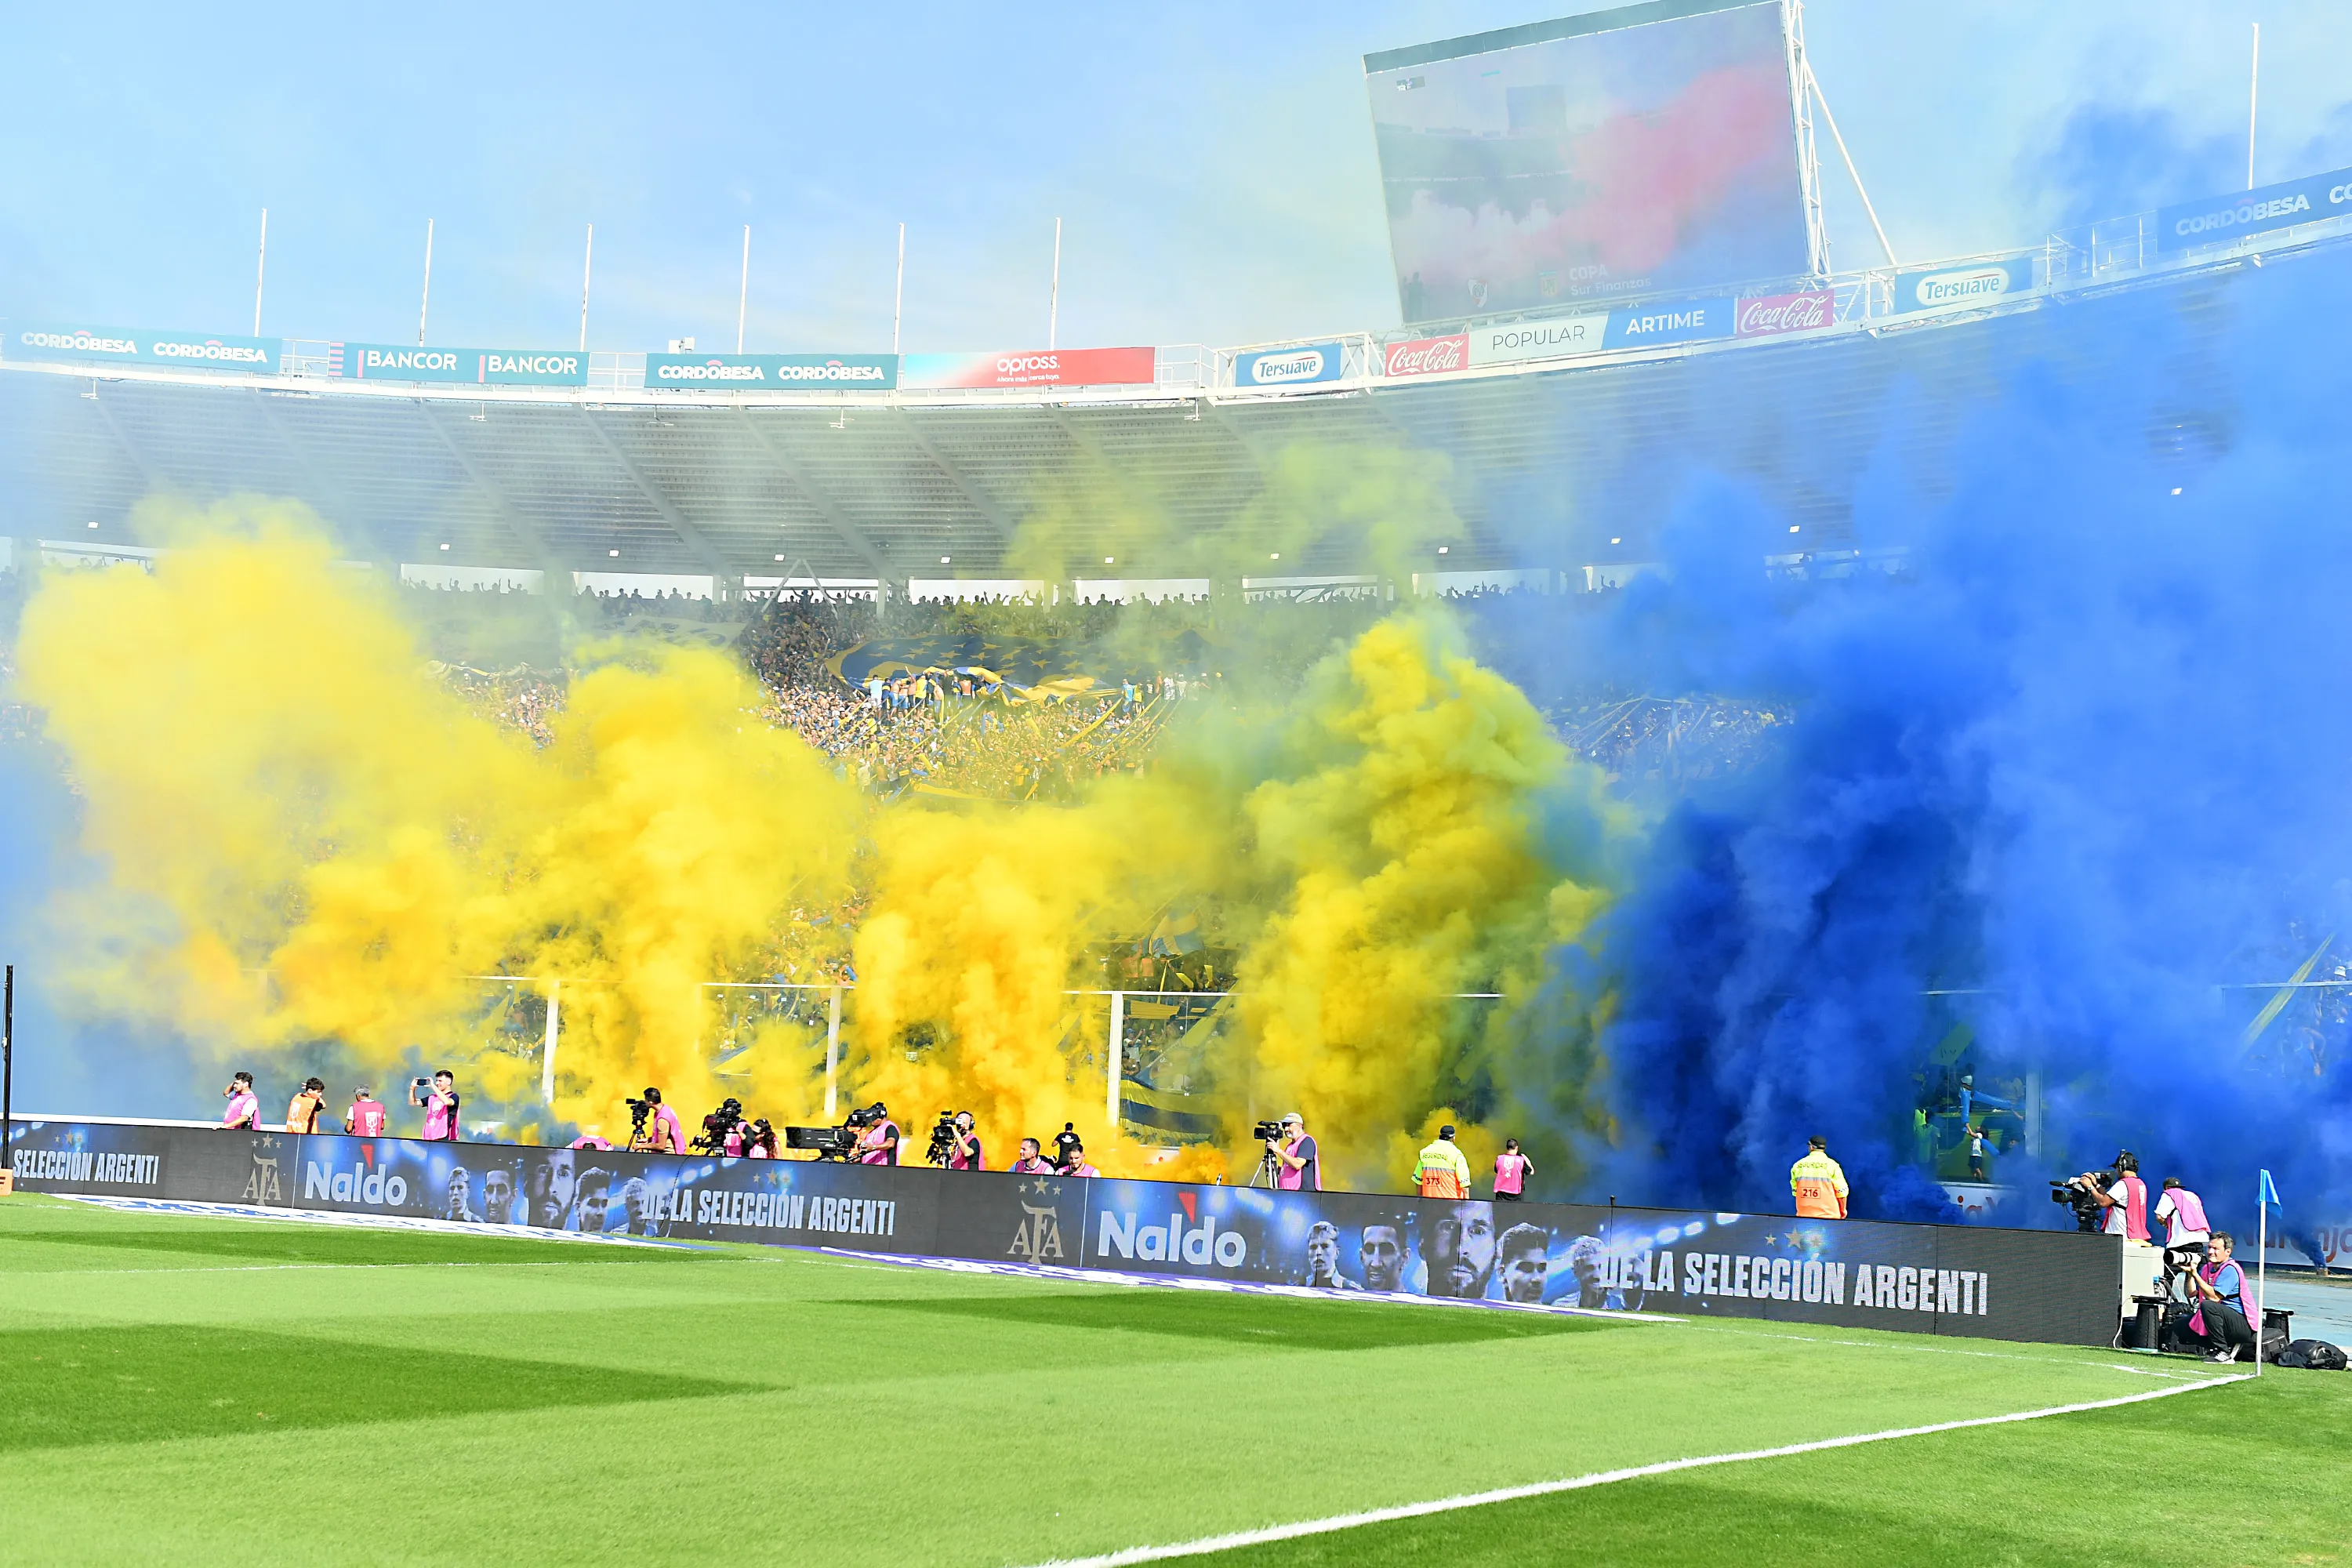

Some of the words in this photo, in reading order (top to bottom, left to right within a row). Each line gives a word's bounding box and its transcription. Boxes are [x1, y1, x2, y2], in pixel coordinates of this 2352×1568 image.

[2176, 194, 2310, 235] CORDOBESA
[1569, 264, 1608, 281] COPA
[1570, 285, 1592, 296] Sur
[1595, 278, 1652, 293] Finanzas
[1924, 277, 2000, 299] Tersuave
[1625, 310, 1705, 335] ARTIME
[1740, 293, 1830, 332] Coca-Cola
[21, 332, 137, 354] CORDOBESA
[1492, 325, 1584, 350] POPULAR
[153, 342, 268, 363] CORDOBESA
[367, 350, 456, 371] BANCOR
[1388, 339, 1465, 376] Coca-Cola
[488, 355, 577, 375] BANCOR
[658, 365, 765, 380] CORDOBESA
[779, 365, 885, 380] CORDOBESA
[1259, 358, 1316, 377] Tersuave
[94, 1152, 159, 1185] ARGENTI
[241, 1152, 282, 1206] AFA
[305, 1160, 407, 1206] Naldo
[1426, 1177, 1440, 1185] 373
[1802, 1189, 1818, 1197] 216
[641, 1192, 665, 1220] DE
[670, 1189, 692, 1222] LA
[698, 1188, 804, 1229] SELECCIÓN
[808, 1196, 895, 1236] ARGENTI
[1007, 1200, 1064, 1265] AFA
[1098, 1210, 1247, 1268] Naldo
[1599, 1254, 1633, 1289] DE
[1642, 1250, 1675, 1292] LA
[1685, 1252, 1846, 1305] SELECCIÓN
[1853, 1263, 1987, 1316] ARGENTI
